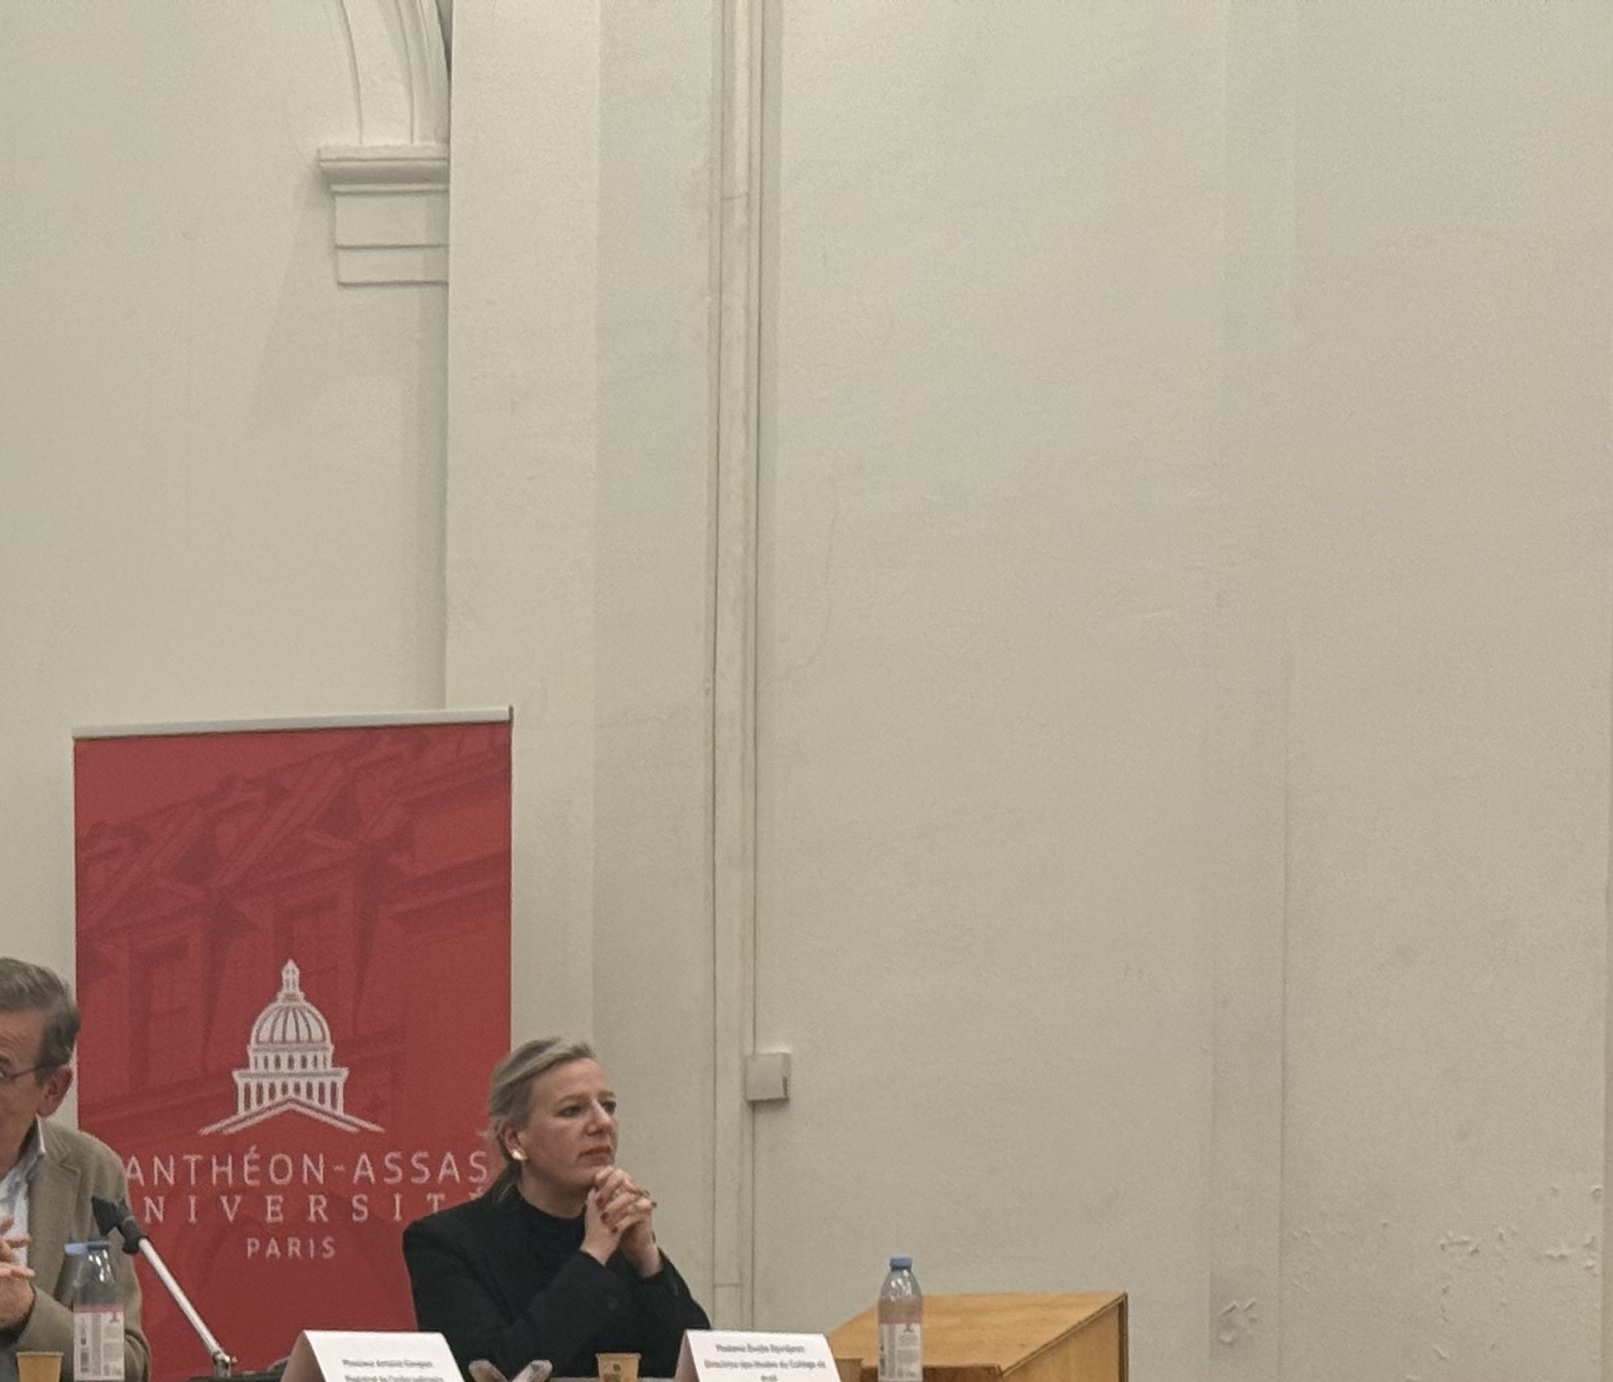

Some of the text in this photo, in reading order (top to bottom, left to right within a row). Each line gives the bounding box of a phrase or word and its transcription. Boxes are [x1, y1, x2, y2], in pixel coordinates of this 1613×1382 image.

[125, 1145, 488, 1188] ANTHÉON-ASSAS
[143, 1187, 486, 1225] NIVERSIT
[246, 1236, 337, 1260] PARIS
